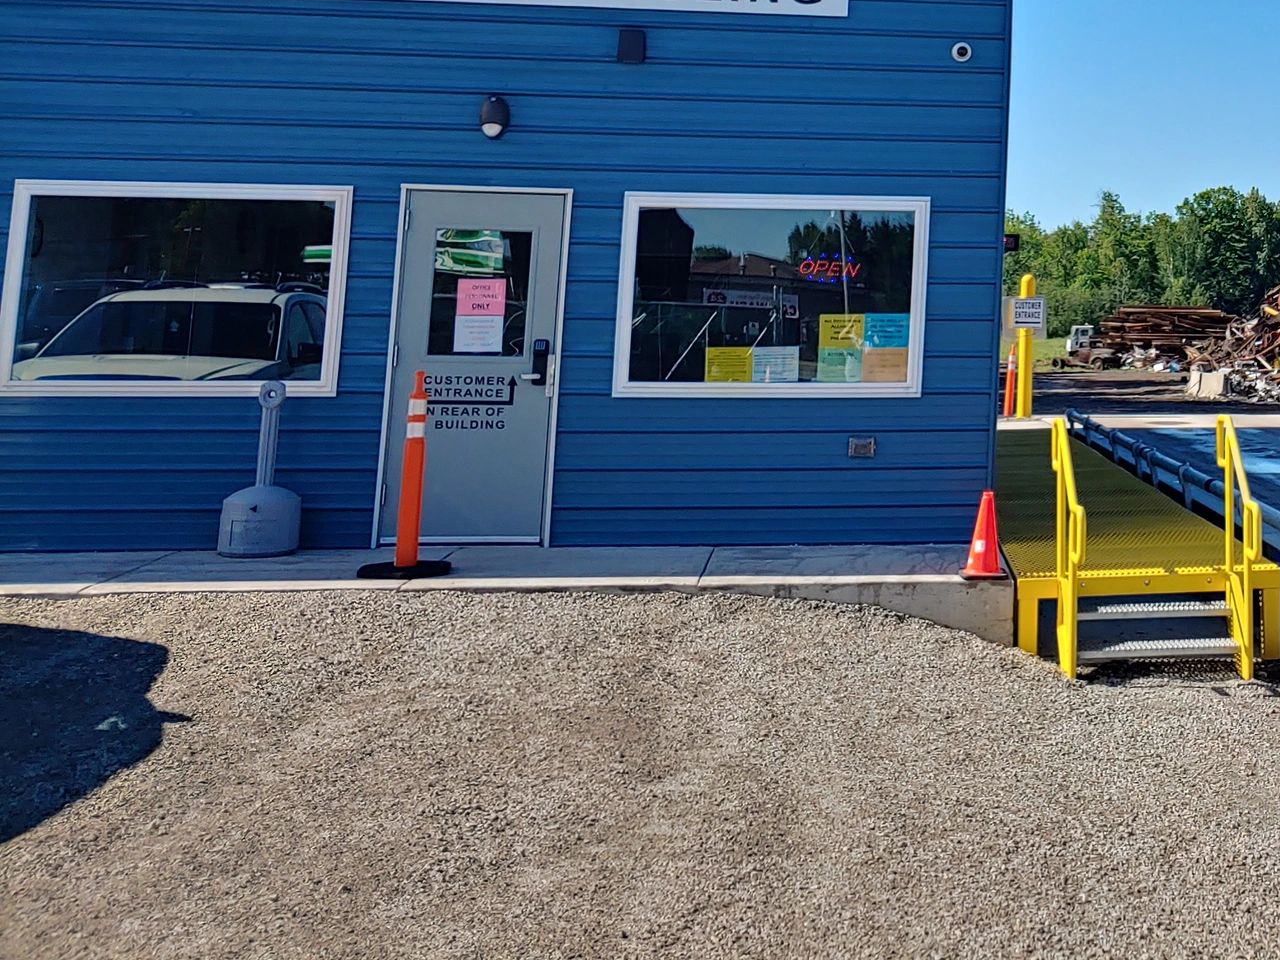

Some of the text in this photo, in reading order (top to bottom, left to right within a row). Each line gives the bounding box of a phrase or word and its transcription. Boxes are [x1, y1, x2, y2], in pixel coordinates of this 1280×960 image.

[799, 260, 861, 278] OPEN
[1015, 301, 1041, 309] CUSTOMER
[1015, 311, 1040, 319] ENTRANCE
[423, 375, 505, 386] CUSTOMER
[424, 387, 504, 398] ENTRANCE
[441, 406, 480, 417] REAR
[485, 407, 505, 417] OF
[434, 420, 505, 430] BUILDING
